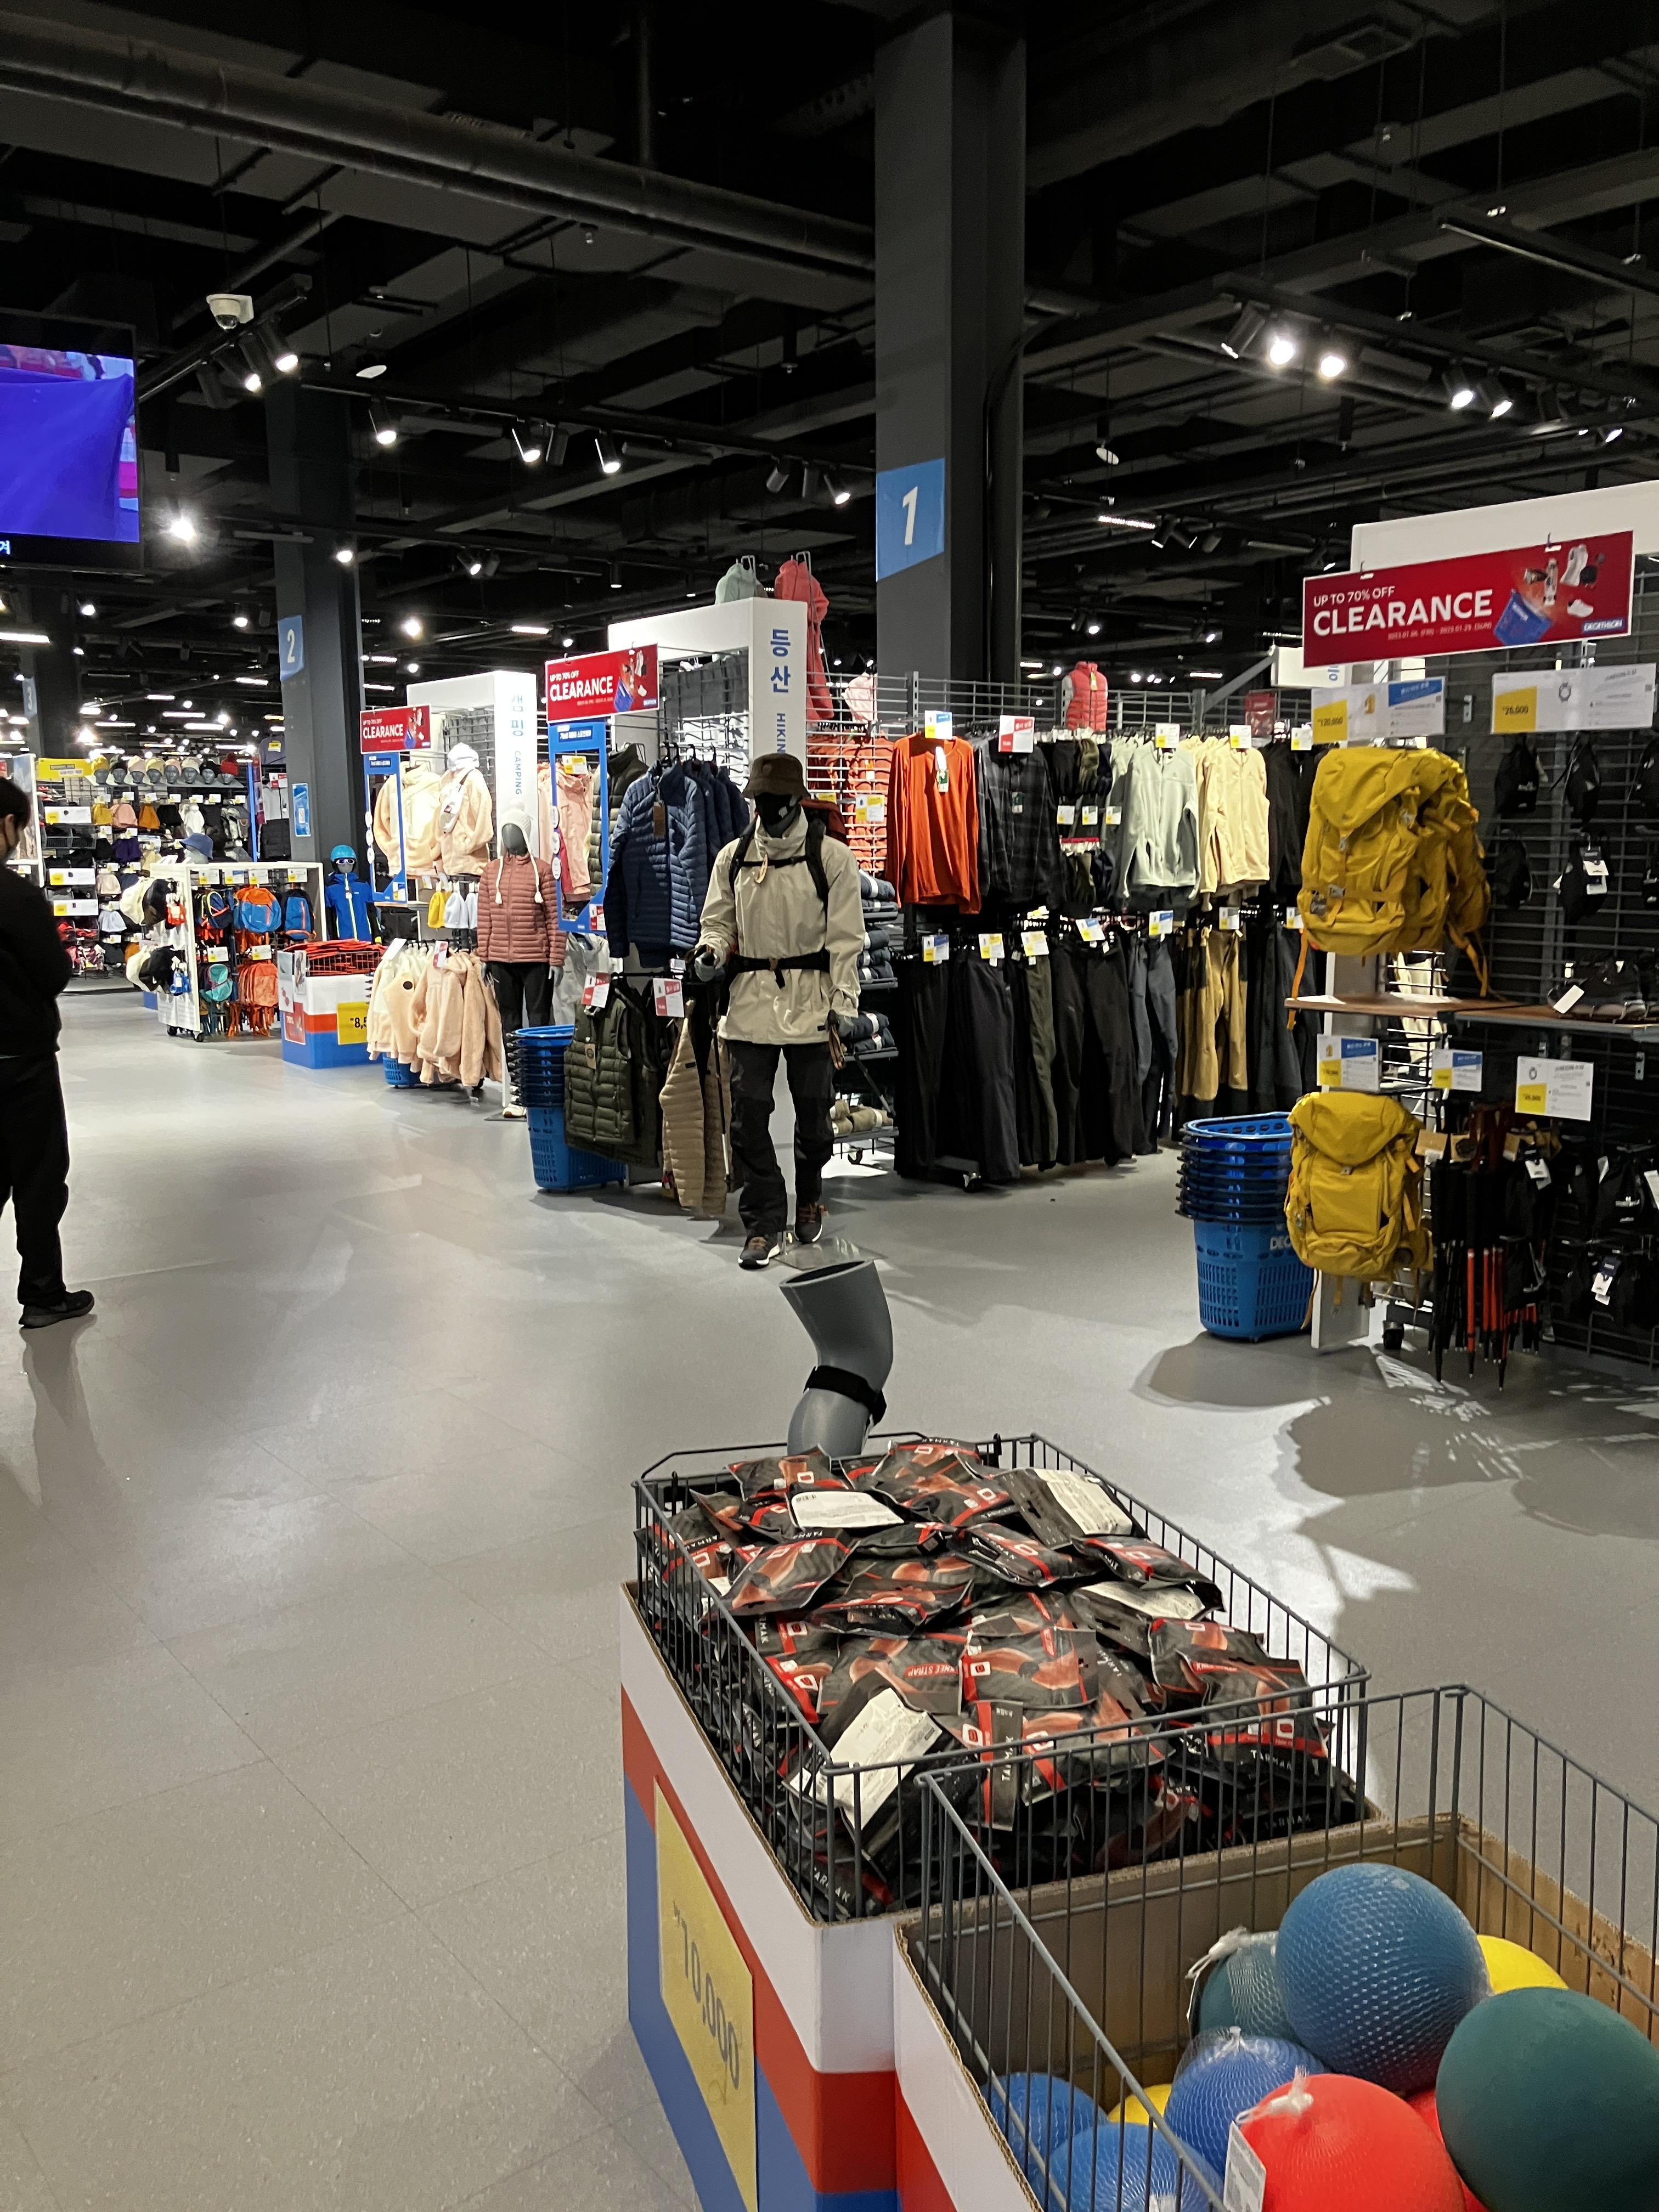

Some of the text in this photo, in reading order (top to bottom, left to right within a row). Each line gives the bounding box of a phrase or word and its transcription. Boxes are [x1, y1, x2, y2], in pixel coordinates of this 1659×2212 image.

[902, 486, 918, 545] 1
[1313, 586, 1395, 607] UP TO 70% OFF
[1313, 589, 1493, 636] CLEARANCE
[287, 629, 295, 663] 2
[770, 629, 791, 693] 등산
[549, 674, 556, 682] UP
[556, 673, 561, 681] TO
[571, 670, 579, 679] OFF
[550, 676, 613, 702] CLEARANCE
[27, 686, 32, 711] 3
[363, 724, 404, 739] CLEARANCE
[777, 713, 786, 754] HIKIN
[908, 1665, 933, 1677] STRAP
[814, 1867, 851, 1903] ARAK
